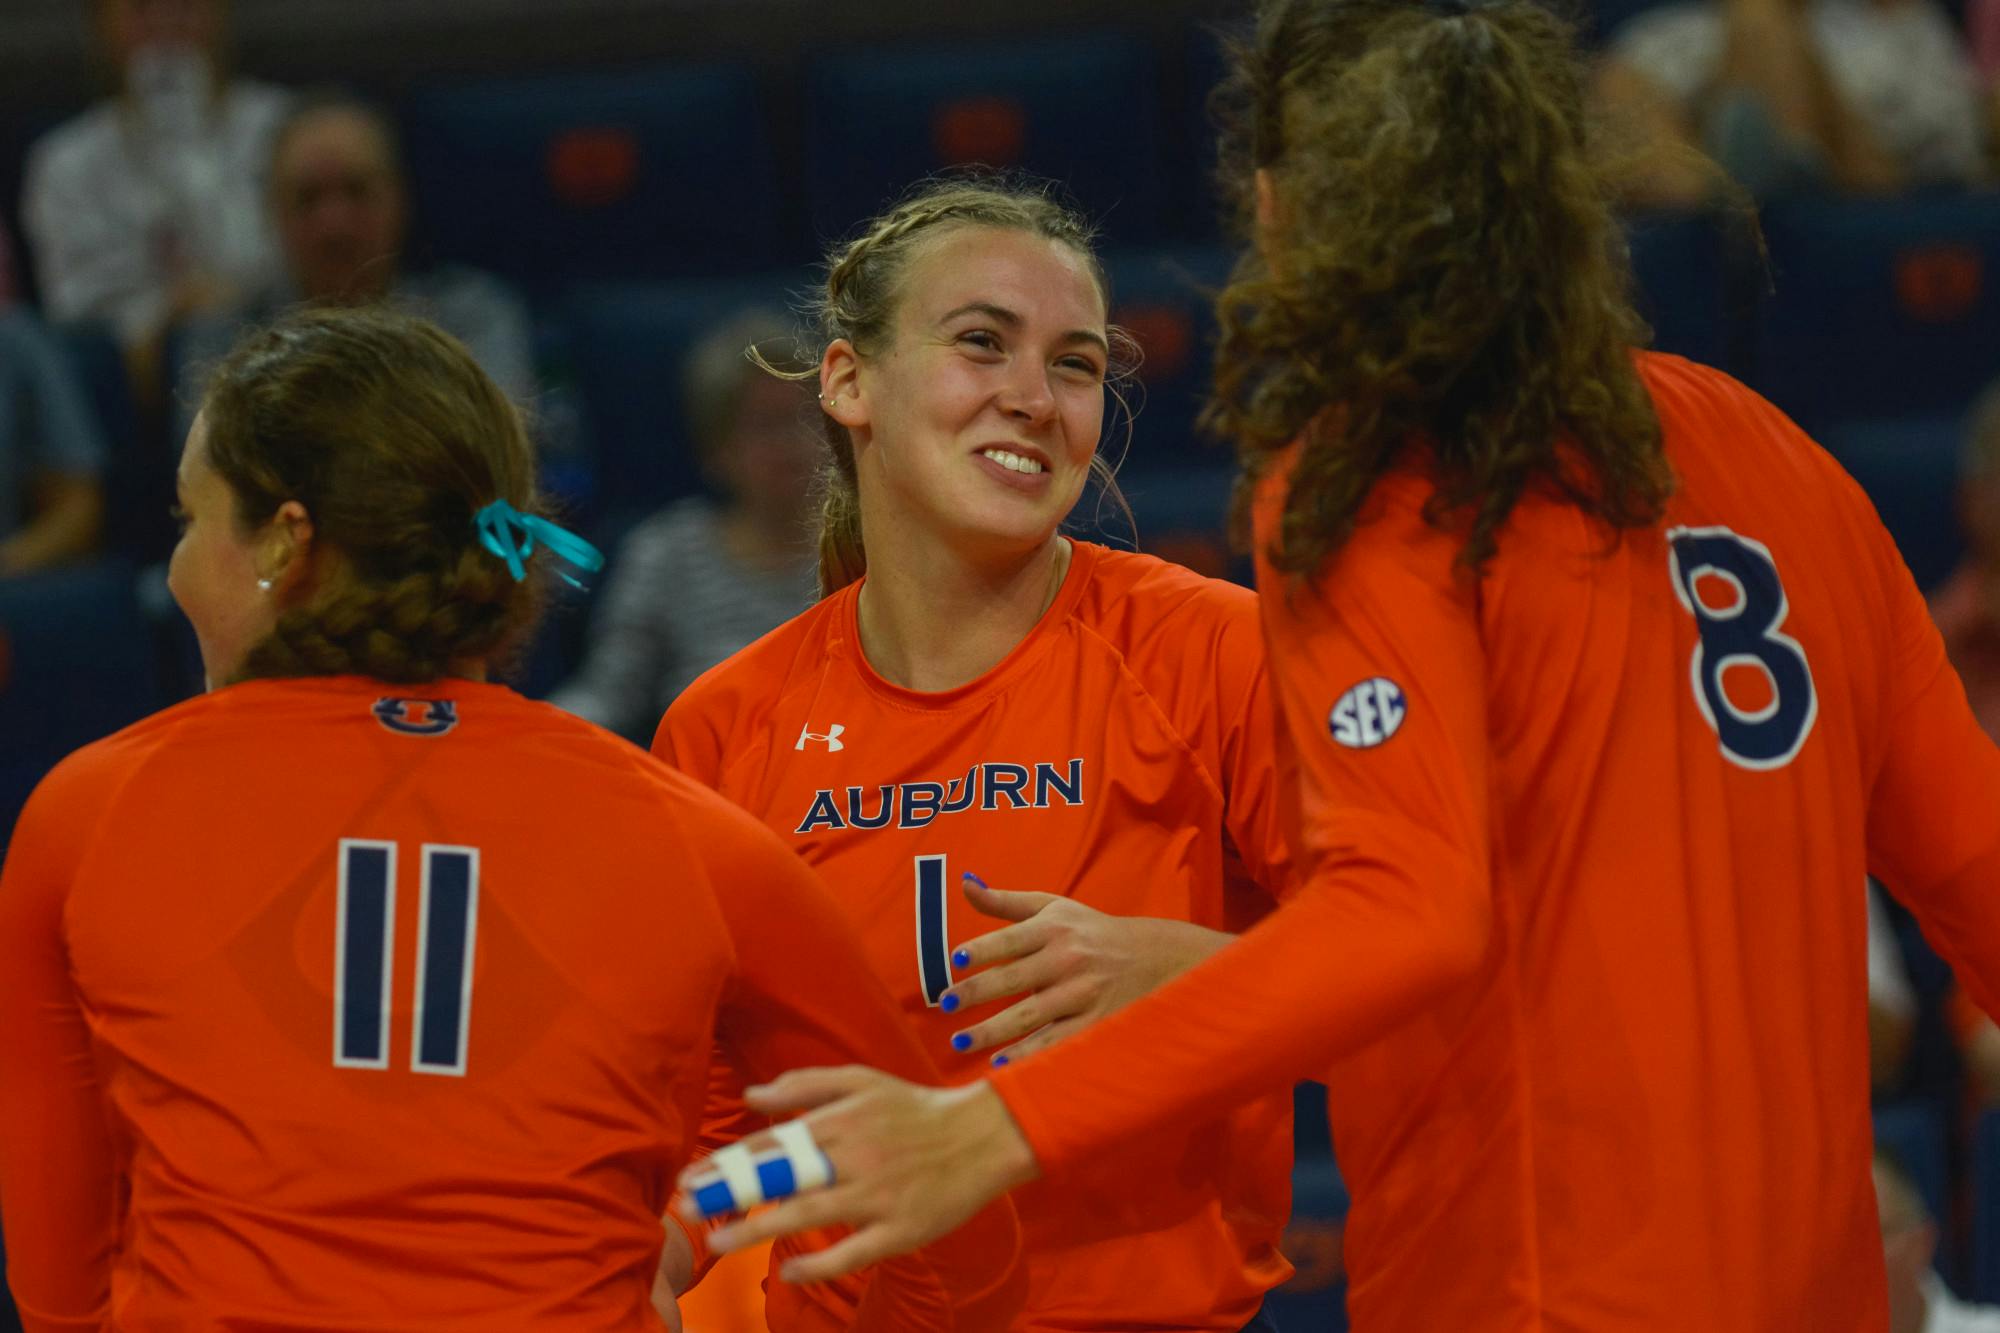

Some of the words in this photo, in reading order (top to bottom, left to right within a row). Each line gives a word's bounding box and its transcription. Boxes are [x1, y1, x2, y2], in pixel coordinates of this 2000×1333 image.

[1329, 677, 1405, 748] SEC
[1665, 525, 1818, 771] 8
[793, 758, 1083, 834] AUBURN
[333, 838, 480, 1077] 11
[914, 853, 954, 1008] 1
